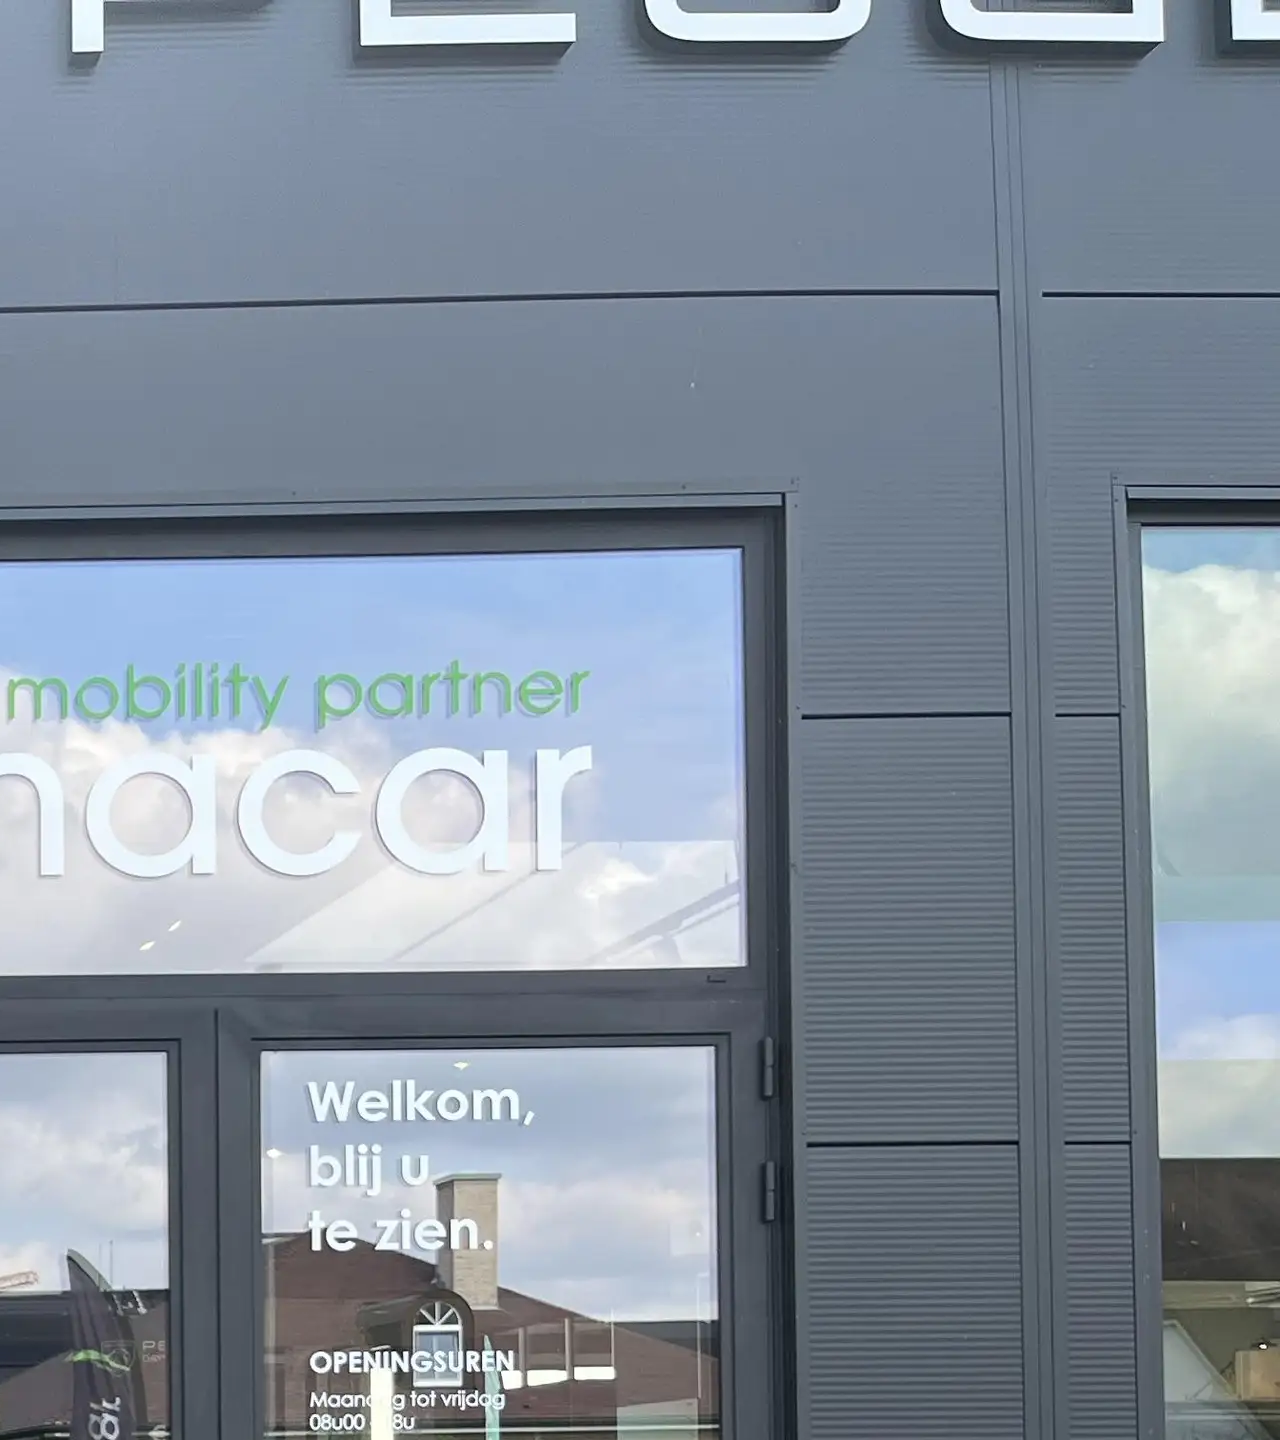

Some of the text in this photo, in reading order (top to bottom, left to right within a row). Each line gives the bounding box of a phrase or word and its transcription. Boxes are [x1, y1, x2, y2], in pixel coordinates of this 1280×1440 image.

[7, 662, 290, 734] mobility
[316, 659, 589, 729] partner
[307, 1079, 536, 1127] Welkom,
[308, 1144, 431, 1197] blij u
[308, 1209, 494, 1254] te zien.
[309, 1350, 514, 1374] OPENINGSUREN
[309, 1390, 505, 1411] Maang tot vrijdag
[309, 1413, 415, 1431] 08u00 8u
